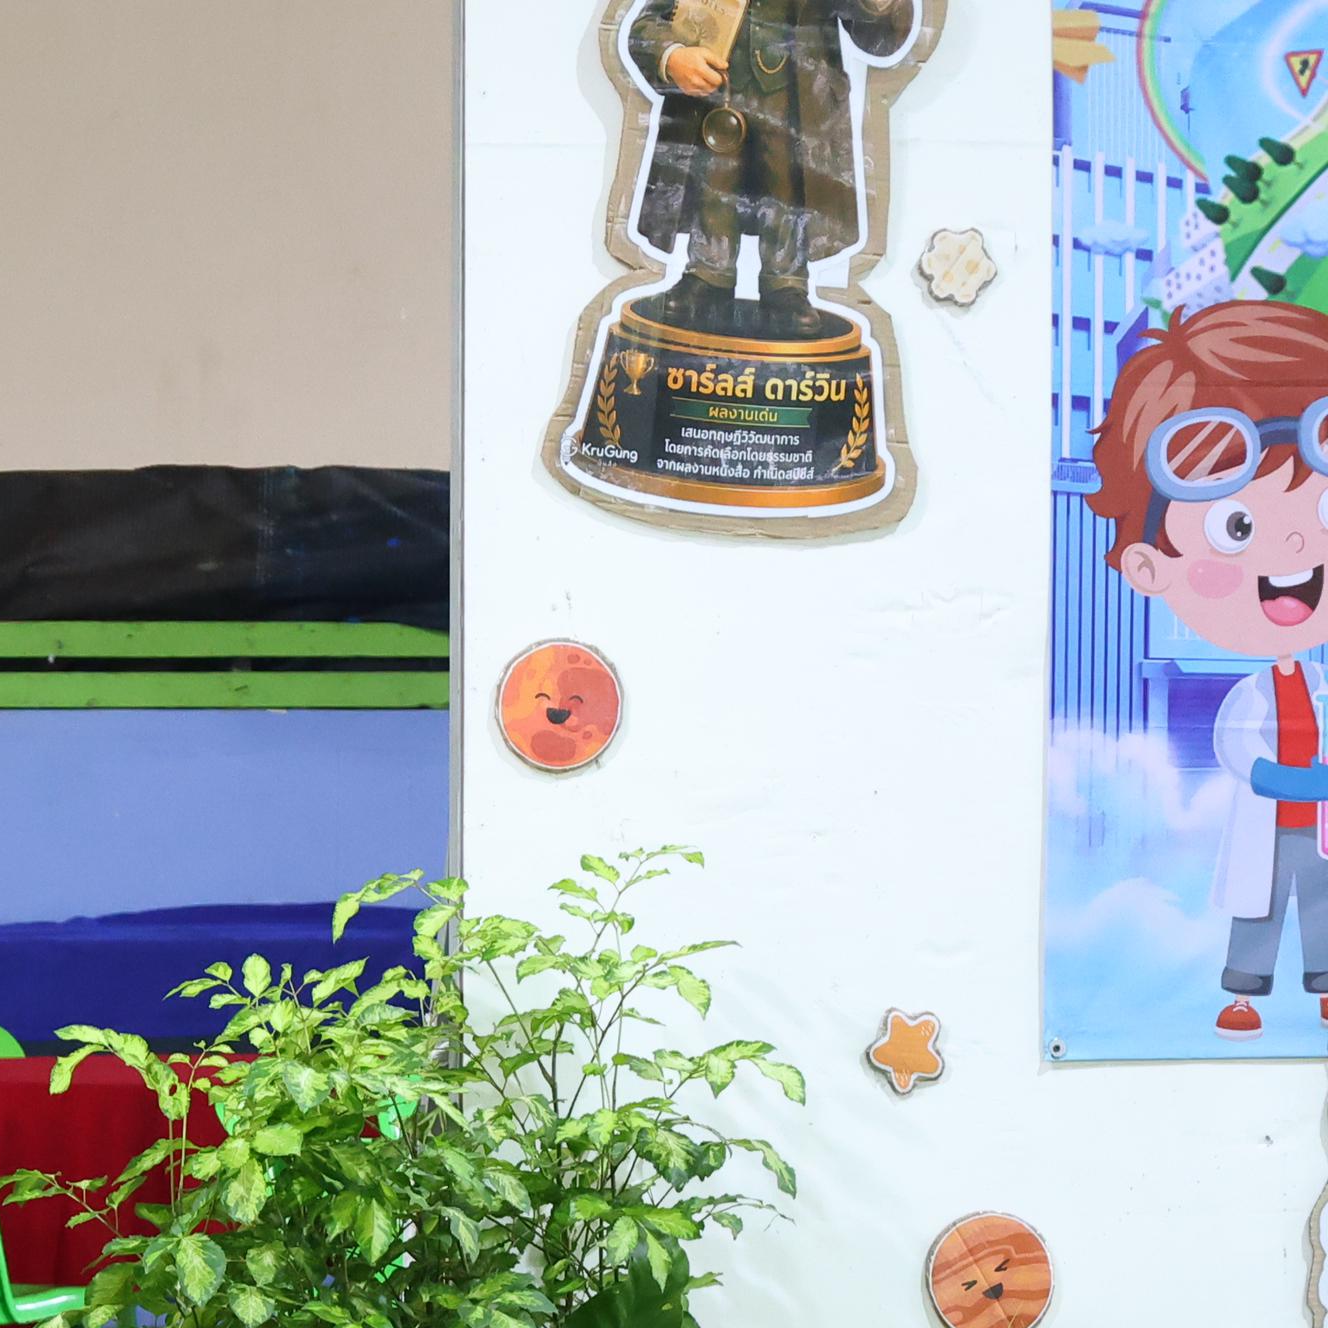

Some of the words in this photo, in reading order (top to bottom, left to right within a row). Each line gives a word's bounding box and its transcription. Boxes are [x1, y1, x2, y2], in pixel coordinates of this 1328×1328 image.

[764, 370, 847, 402] ดาร์วิน
[708, 406, 778, 422] ผลงานเด่น
[581, 442, 639, 463] KruGung
